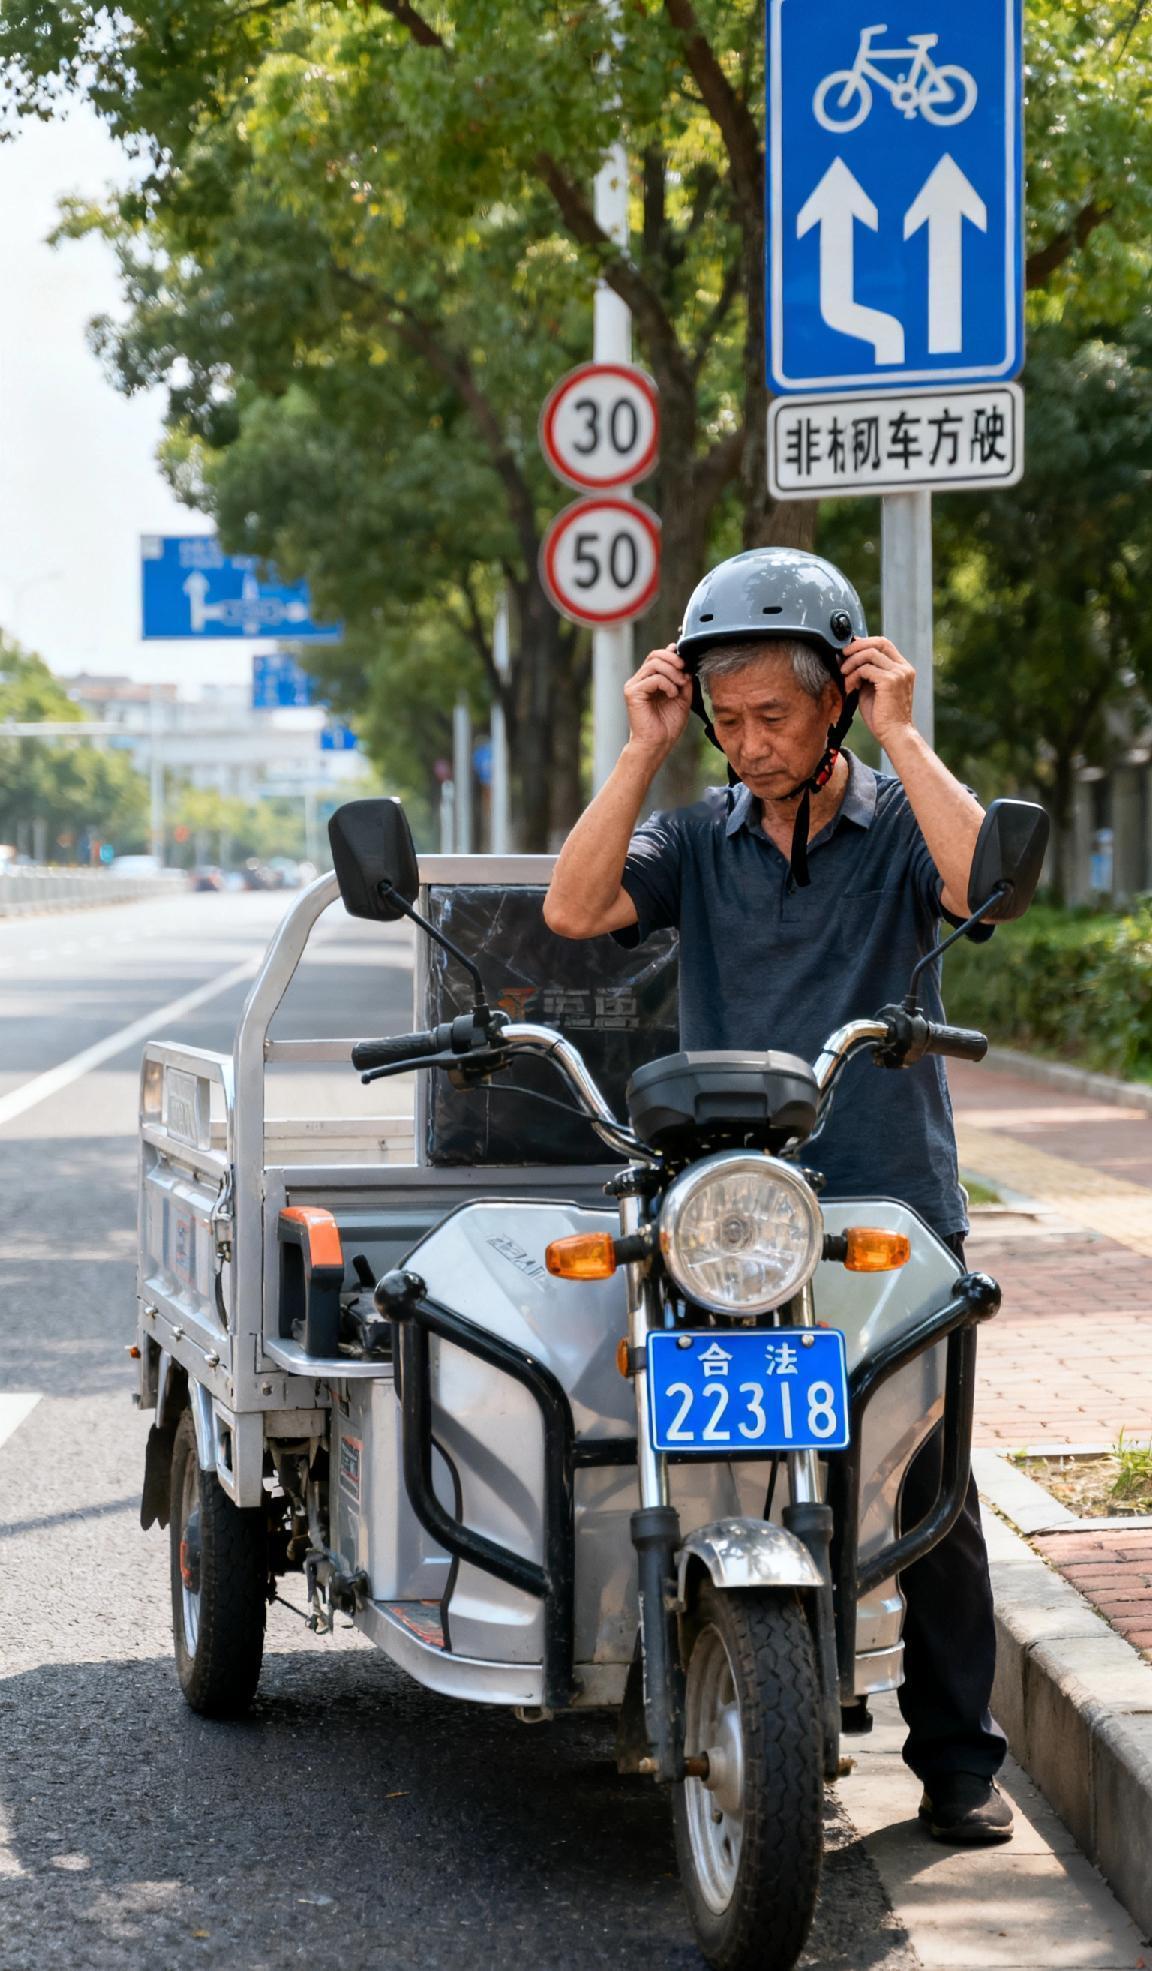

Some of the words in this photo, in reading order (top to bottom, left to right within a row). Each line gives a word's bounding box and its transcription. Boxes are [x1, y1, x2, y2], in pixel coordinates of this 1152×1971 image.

[573, 397, 639, 455] 30
[573, 531, 639, 589] 50
[697, 1342, 798, 1377] 合法
[665, 1380, 837, 1441] 22318
